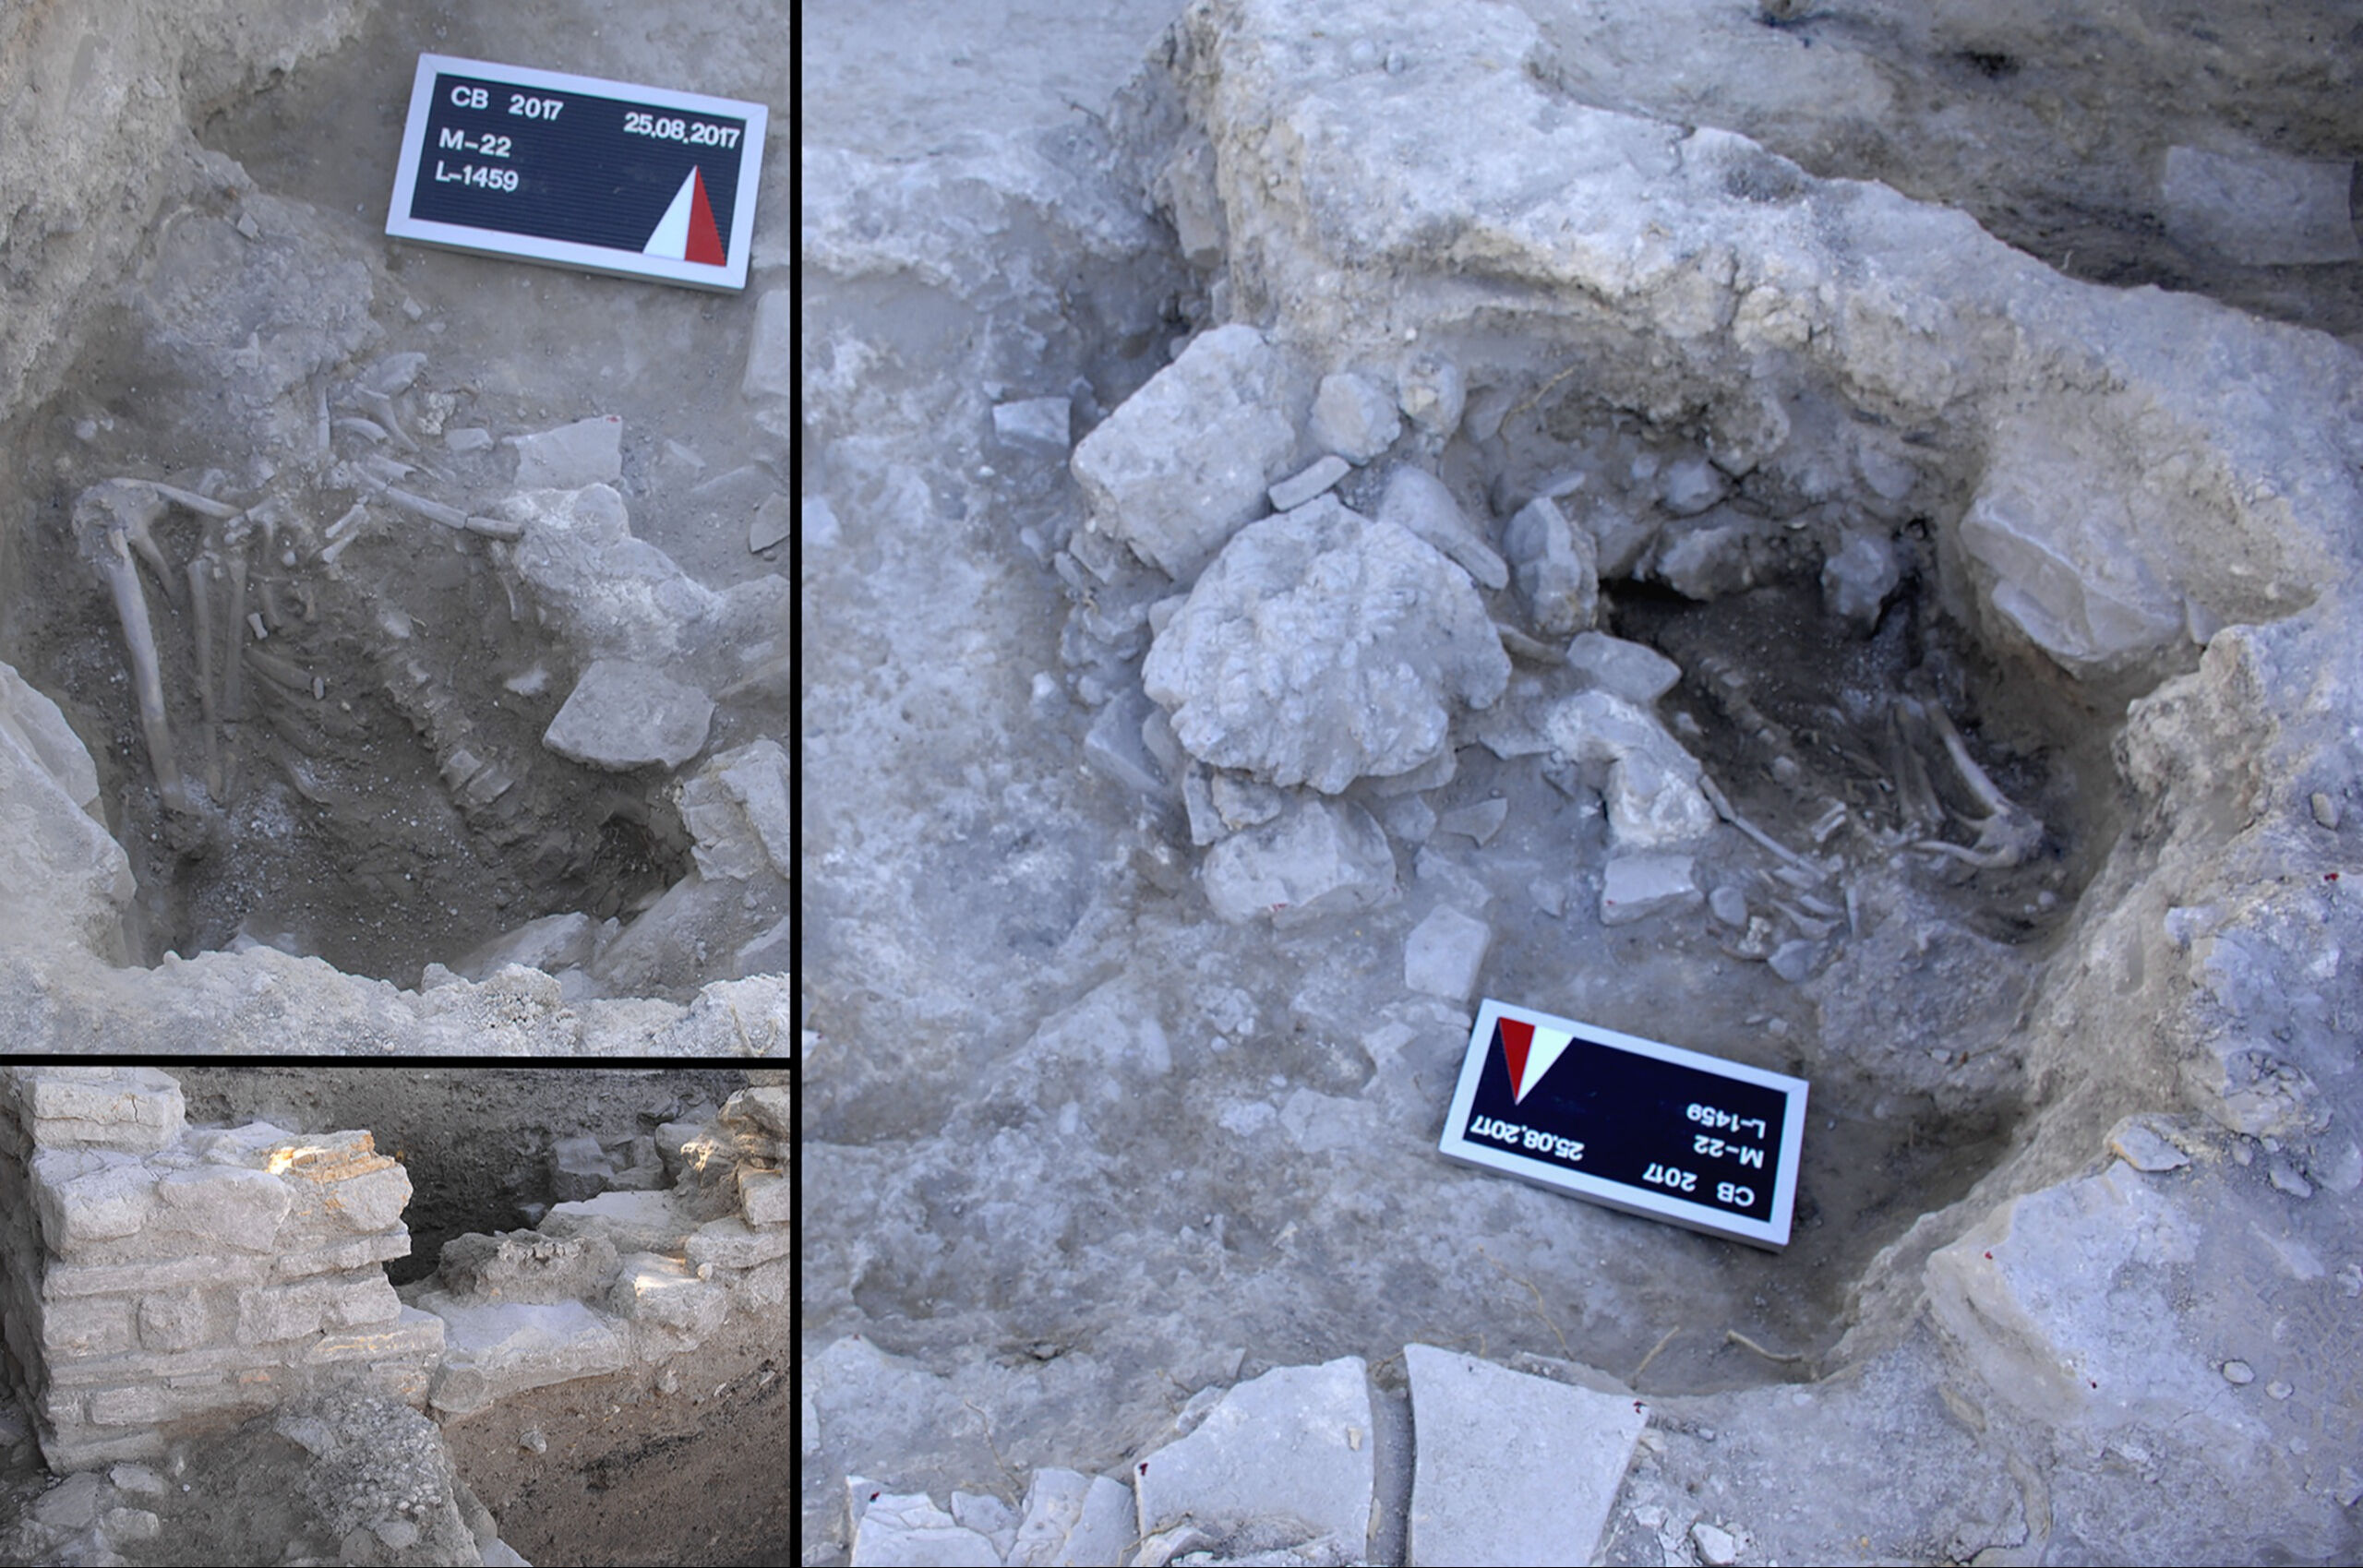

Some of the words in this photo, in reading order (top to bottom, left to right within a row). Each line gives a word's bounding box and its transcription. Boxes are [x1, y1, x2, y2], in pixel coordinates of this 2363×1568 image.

[450, 86, 489, 110] CB
[509, 94, 564, 121] 2017
[623, 111, 740, 149] 25.08.2017
[438, 127, 512, 158] M-22
[435, 160, 520, 193] L-1459
[1469, 1115, 1585, 1161] 25.08.2017
[1686, 1103, 1767, 1139] L-1459
[1693, 1134, 1764, 1169] M-22
[1642, 1163, 1697, 1192] 2017
[1716, 1181, 1755, 1207] CB
